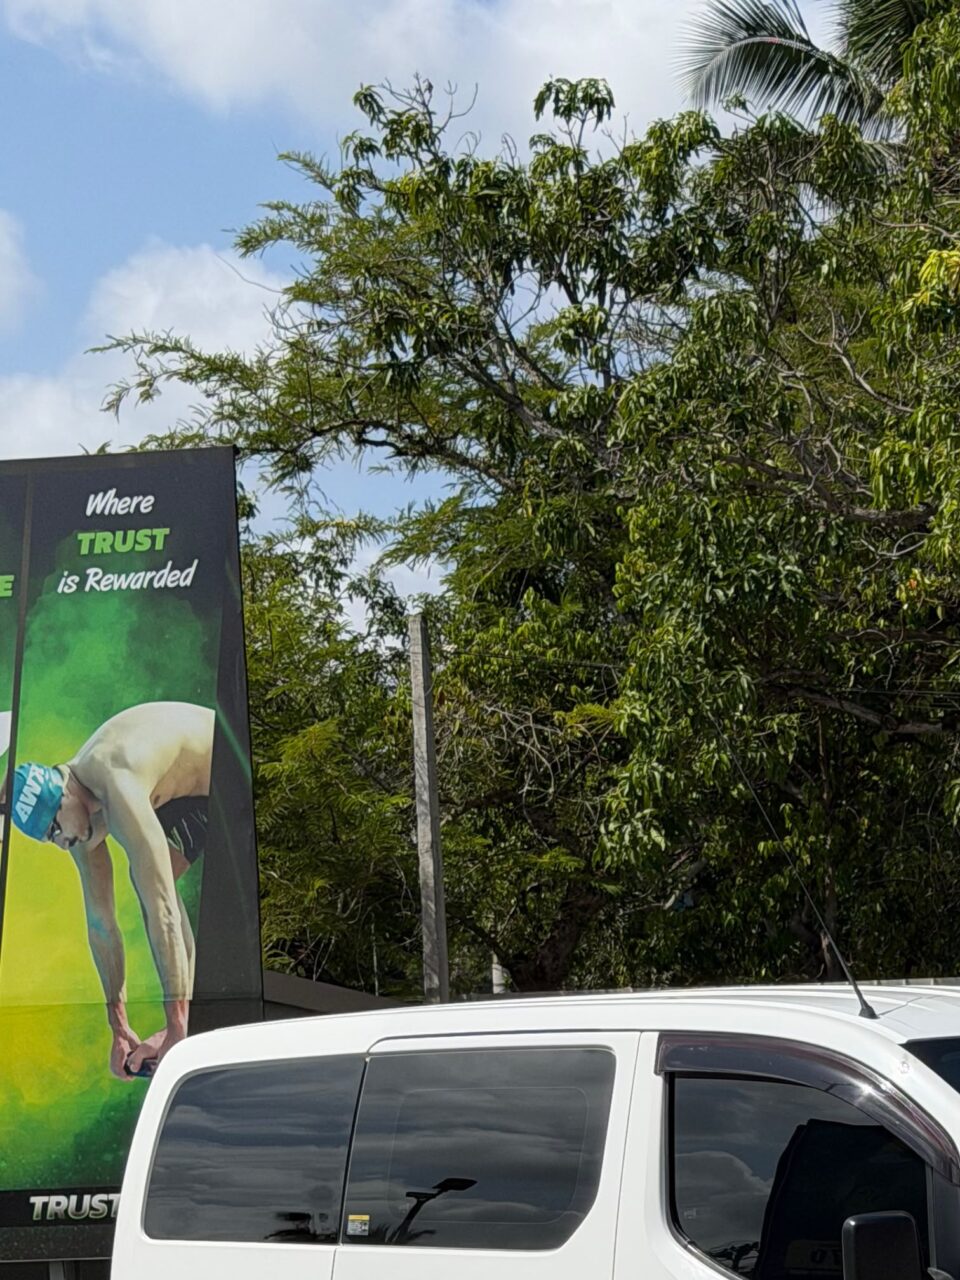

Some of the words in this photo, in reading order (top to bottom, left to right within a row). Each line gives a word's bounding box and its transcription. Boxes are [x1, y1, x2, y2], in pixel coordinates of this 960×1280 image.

[85, 488, 155, 517] Where
[77, 528, 170, 555] TRUST
[57, 570, 80, 594] is
[84, 559, 199, 592] Rewarded
[29, 1193, 121, 1220] TRUST
